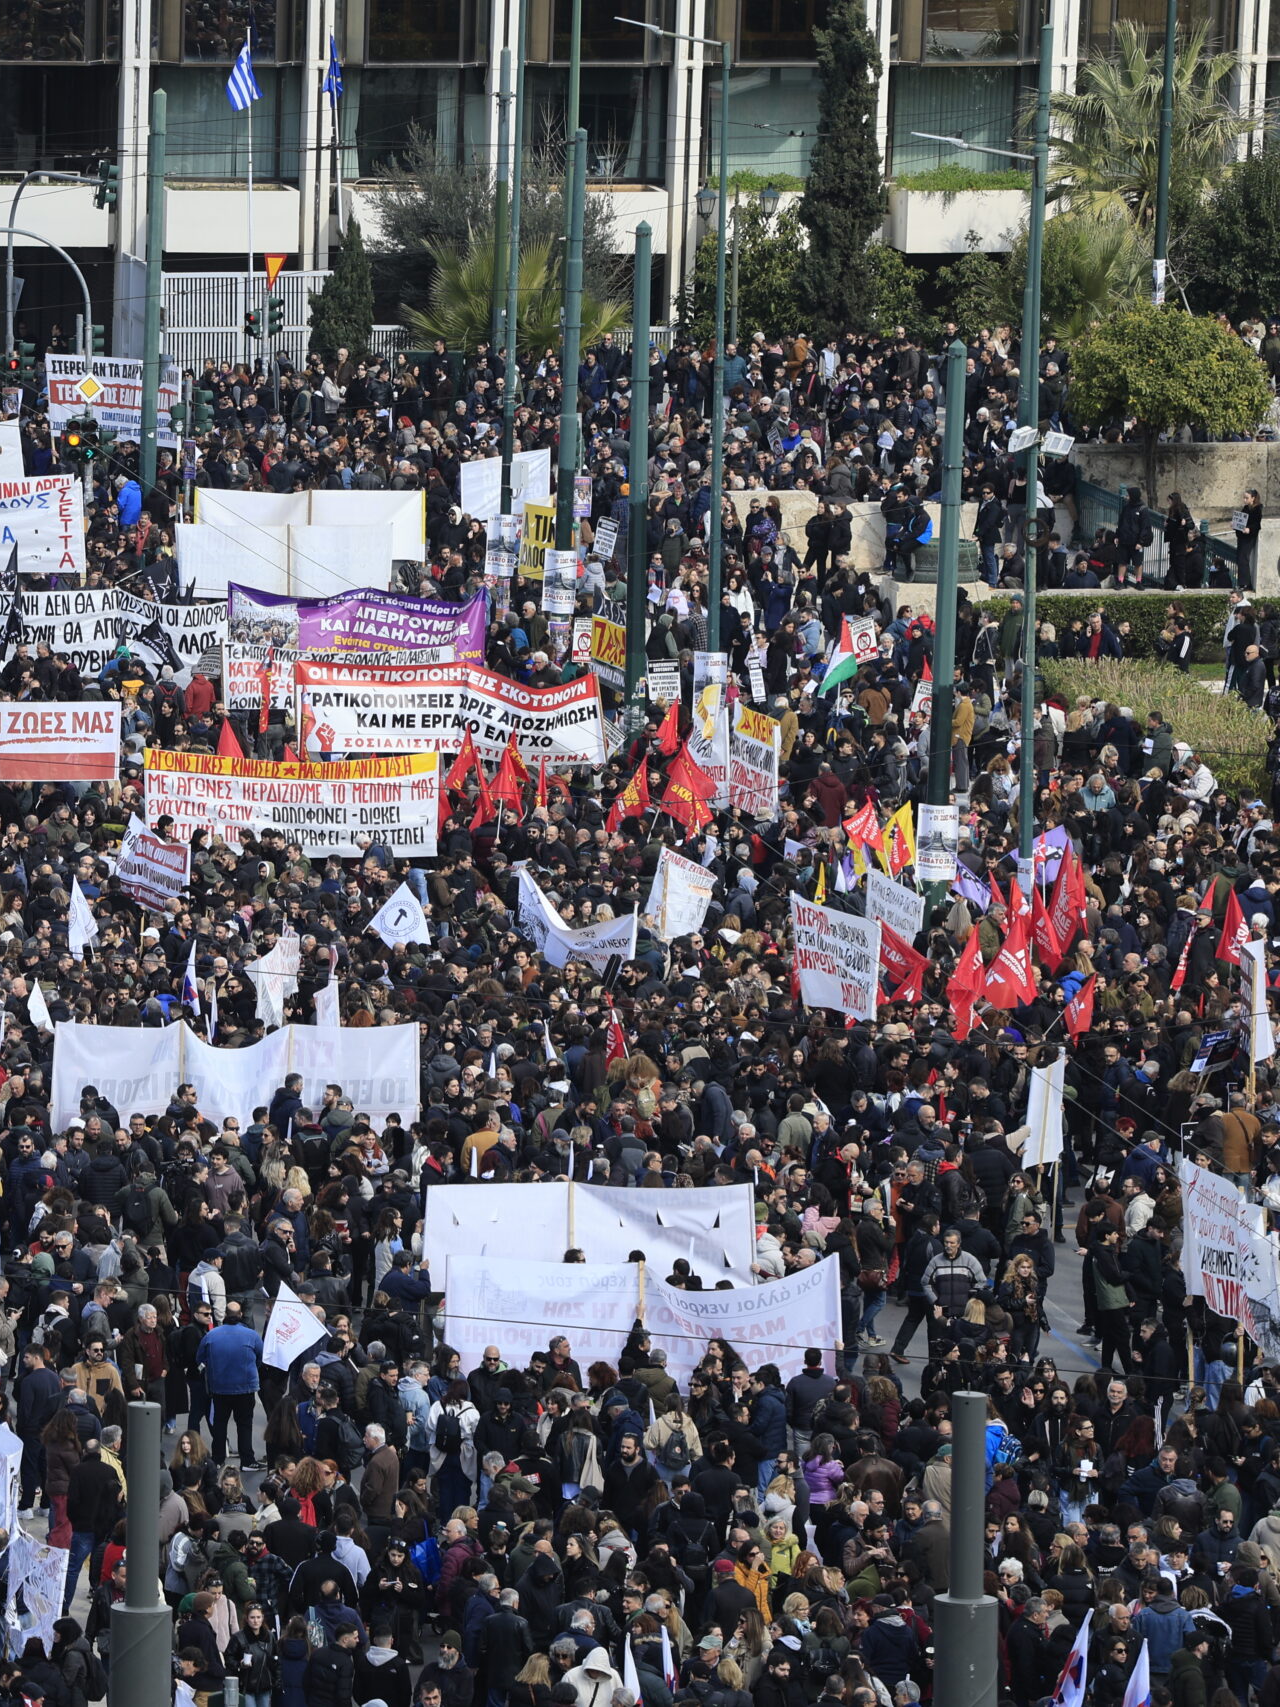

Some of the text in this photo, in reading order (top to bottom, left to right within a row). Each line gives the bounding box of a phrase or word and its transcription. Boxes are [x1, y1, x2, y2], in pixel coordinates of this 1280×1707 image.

[45, 592, 179, 626] ΔΕΝ ΘΑ ΟΙ
[355, 605, 455, 631] ΑΠΕΡΓΟΥΜΕ
[63, 622, 218, 655] ΘΑ ΛΑΟΣ
[320, 618, 350, 632] ΚΑΙ
[308, 666, 587, 708] ΟΙ ΙΔΙΩΤΙΚΟΠΟΙΗΣΕΙΣ ΣΚΟΤΩΝΟΥΝ
[7, 711, 67, 734] ΖΩΕΣ
[72, 711, 114, 734] ΜΑΣ
[357, 713, 416, 729] ΚΑΙ ΜΕ
[497, 704, 598, 733] ΑΠΟΖΗΜΙΩΣΗ
[149, 750, 226, 775] ΑΓΩΝΙΣΤΙΚΕΣ
[231, 757, 281, 778] ΚΙΝΗΣΕΙΣ
[351, 755, 412, 779] ΑΝΤΙΣΤΑΣΗ
[530, 751, 590, 764] ΚΟΜΜΑ
[148, 773, 169, 795] ΜΕ
[177, 776, 233, 799] ΑΓΩΝΕΣ
[242, 781, 322, 804] ΚΕΡΔΙΖΟΥΜΕ
[330, 783, 346, 803] ΤΟ
[410, 776, 435, 799] ΜΑΣ
